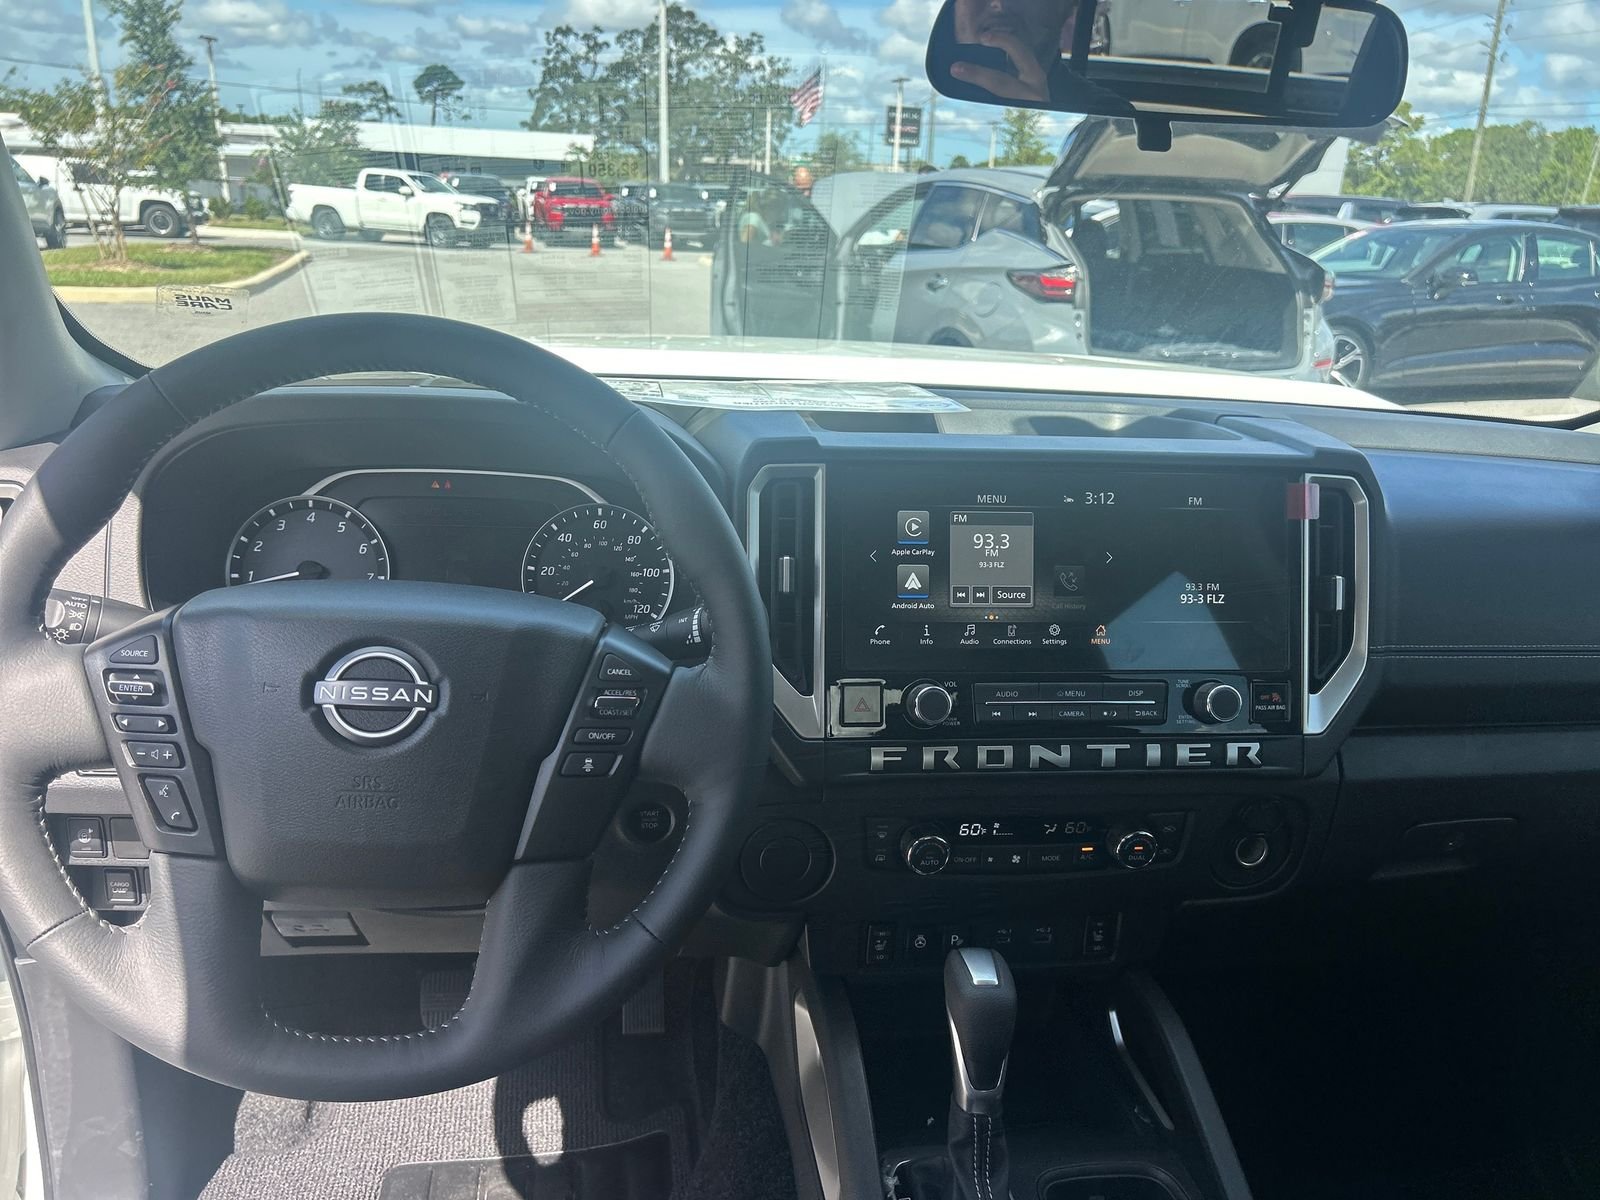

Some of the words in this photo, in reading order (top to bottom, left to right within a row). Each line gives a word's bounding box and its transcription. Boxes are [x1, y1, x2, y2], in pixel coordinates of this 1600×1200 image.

[977, 495, 1006, 504] MENU
[1085, 492, 1114, 504] 3:12
[1188, 496, 1202, 506] FM
[306, 512, 316, 522] 4
[953, 514, 968, 522] FM
[276, 520, 286, 530] 3
[337, 522, 346, 532] 5
[594, 520, 607, 529] 60
[558, 534, 572, 542] 40
[627, 535, 641, 544] 80
[973, 534, 1010, 549] 93.3
[254, 540, 263, 552] 2
[359, 544, 368, 554] 6
[892, 549, 909, 557] Apple
[910, 549, 935, 557] CarPlay
[248, 570, 254, 581] 1
[540, 566, 554, 576] 20
[643, 568, 660, 578] 100
[1185, 583, 1203, 591] 93.3
[1206, 583, 1220, 591] FM
[997, 590, 1026, 599] Source
[1180, 594, 1205, 604] 93-3
[1206, 594, 1225, 604] FLZ
[64, 600, 88, 608] AUTO
[634, 605, 650, 613] 120
[1042, 638, 1067, 646] Settings
[120, 649, 148, 658] SOURCE
[119, 684, 143, 692] ENTER
[319, 686, 433, 703] NISSAN
[588, 732, 616, 740] ON/OFF
[870, 742, 1262, 770] FRONTIER
[353, 776, 383, 789] SRS
[335, 793, 400, 808] AIRBAG
